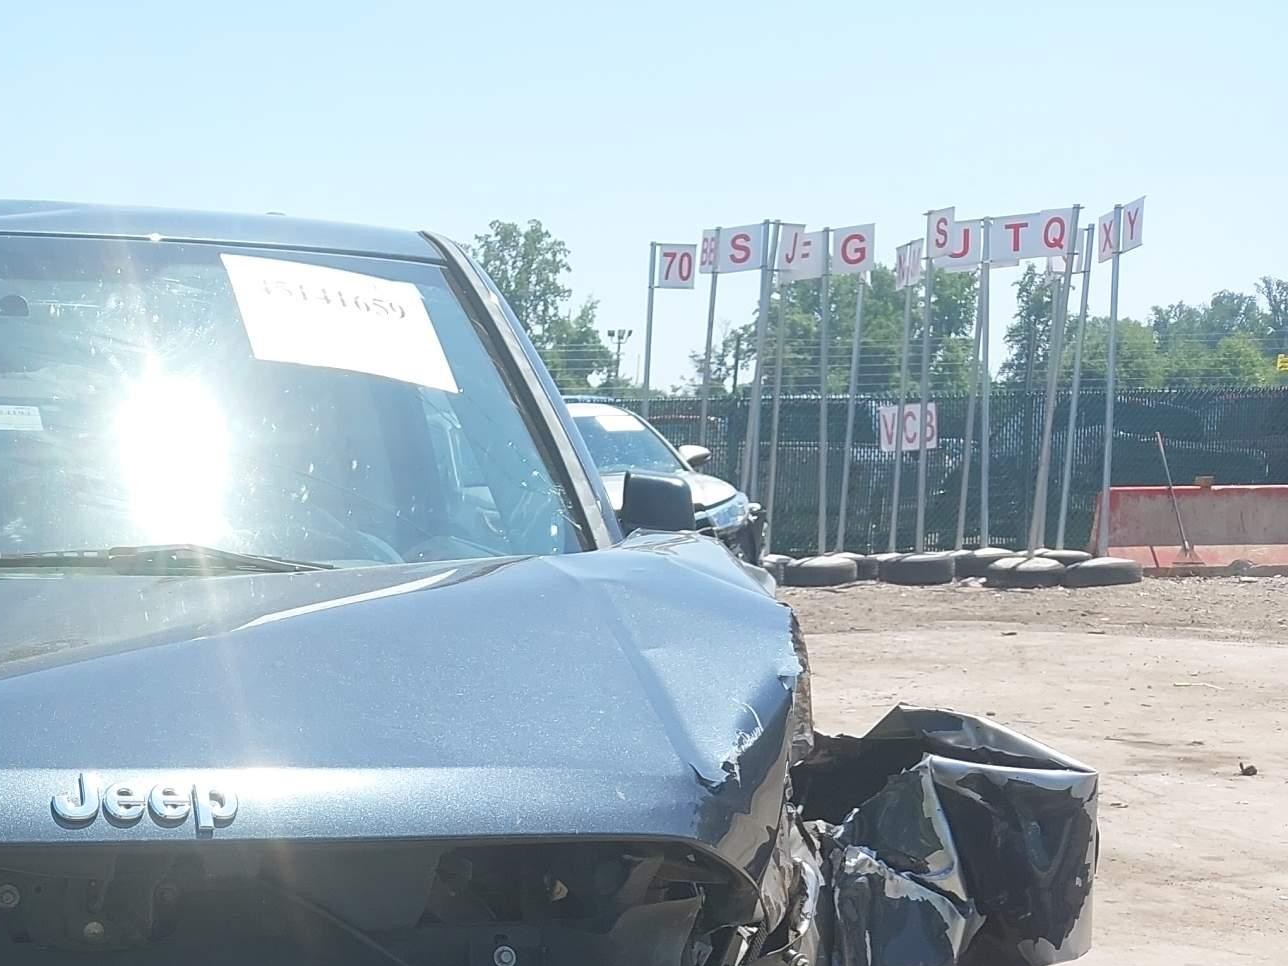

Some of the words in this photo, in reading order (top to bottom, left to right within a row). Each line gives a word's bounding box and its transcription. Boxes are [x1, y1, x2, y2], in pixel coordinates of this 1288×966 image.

[935, 217, 948, 249] S
[1004, 222, 1029, 252] T
[1044, 216, 1066, 249] Q
[1127, 207, 1139, 240] Y
[729, 233, 751, 264] S
[841, 233, 866, 265] G
[948, 228, 970, 259] J
[663, 251, 693, 281] 70
[51, 772, 239, 836] Jeep
